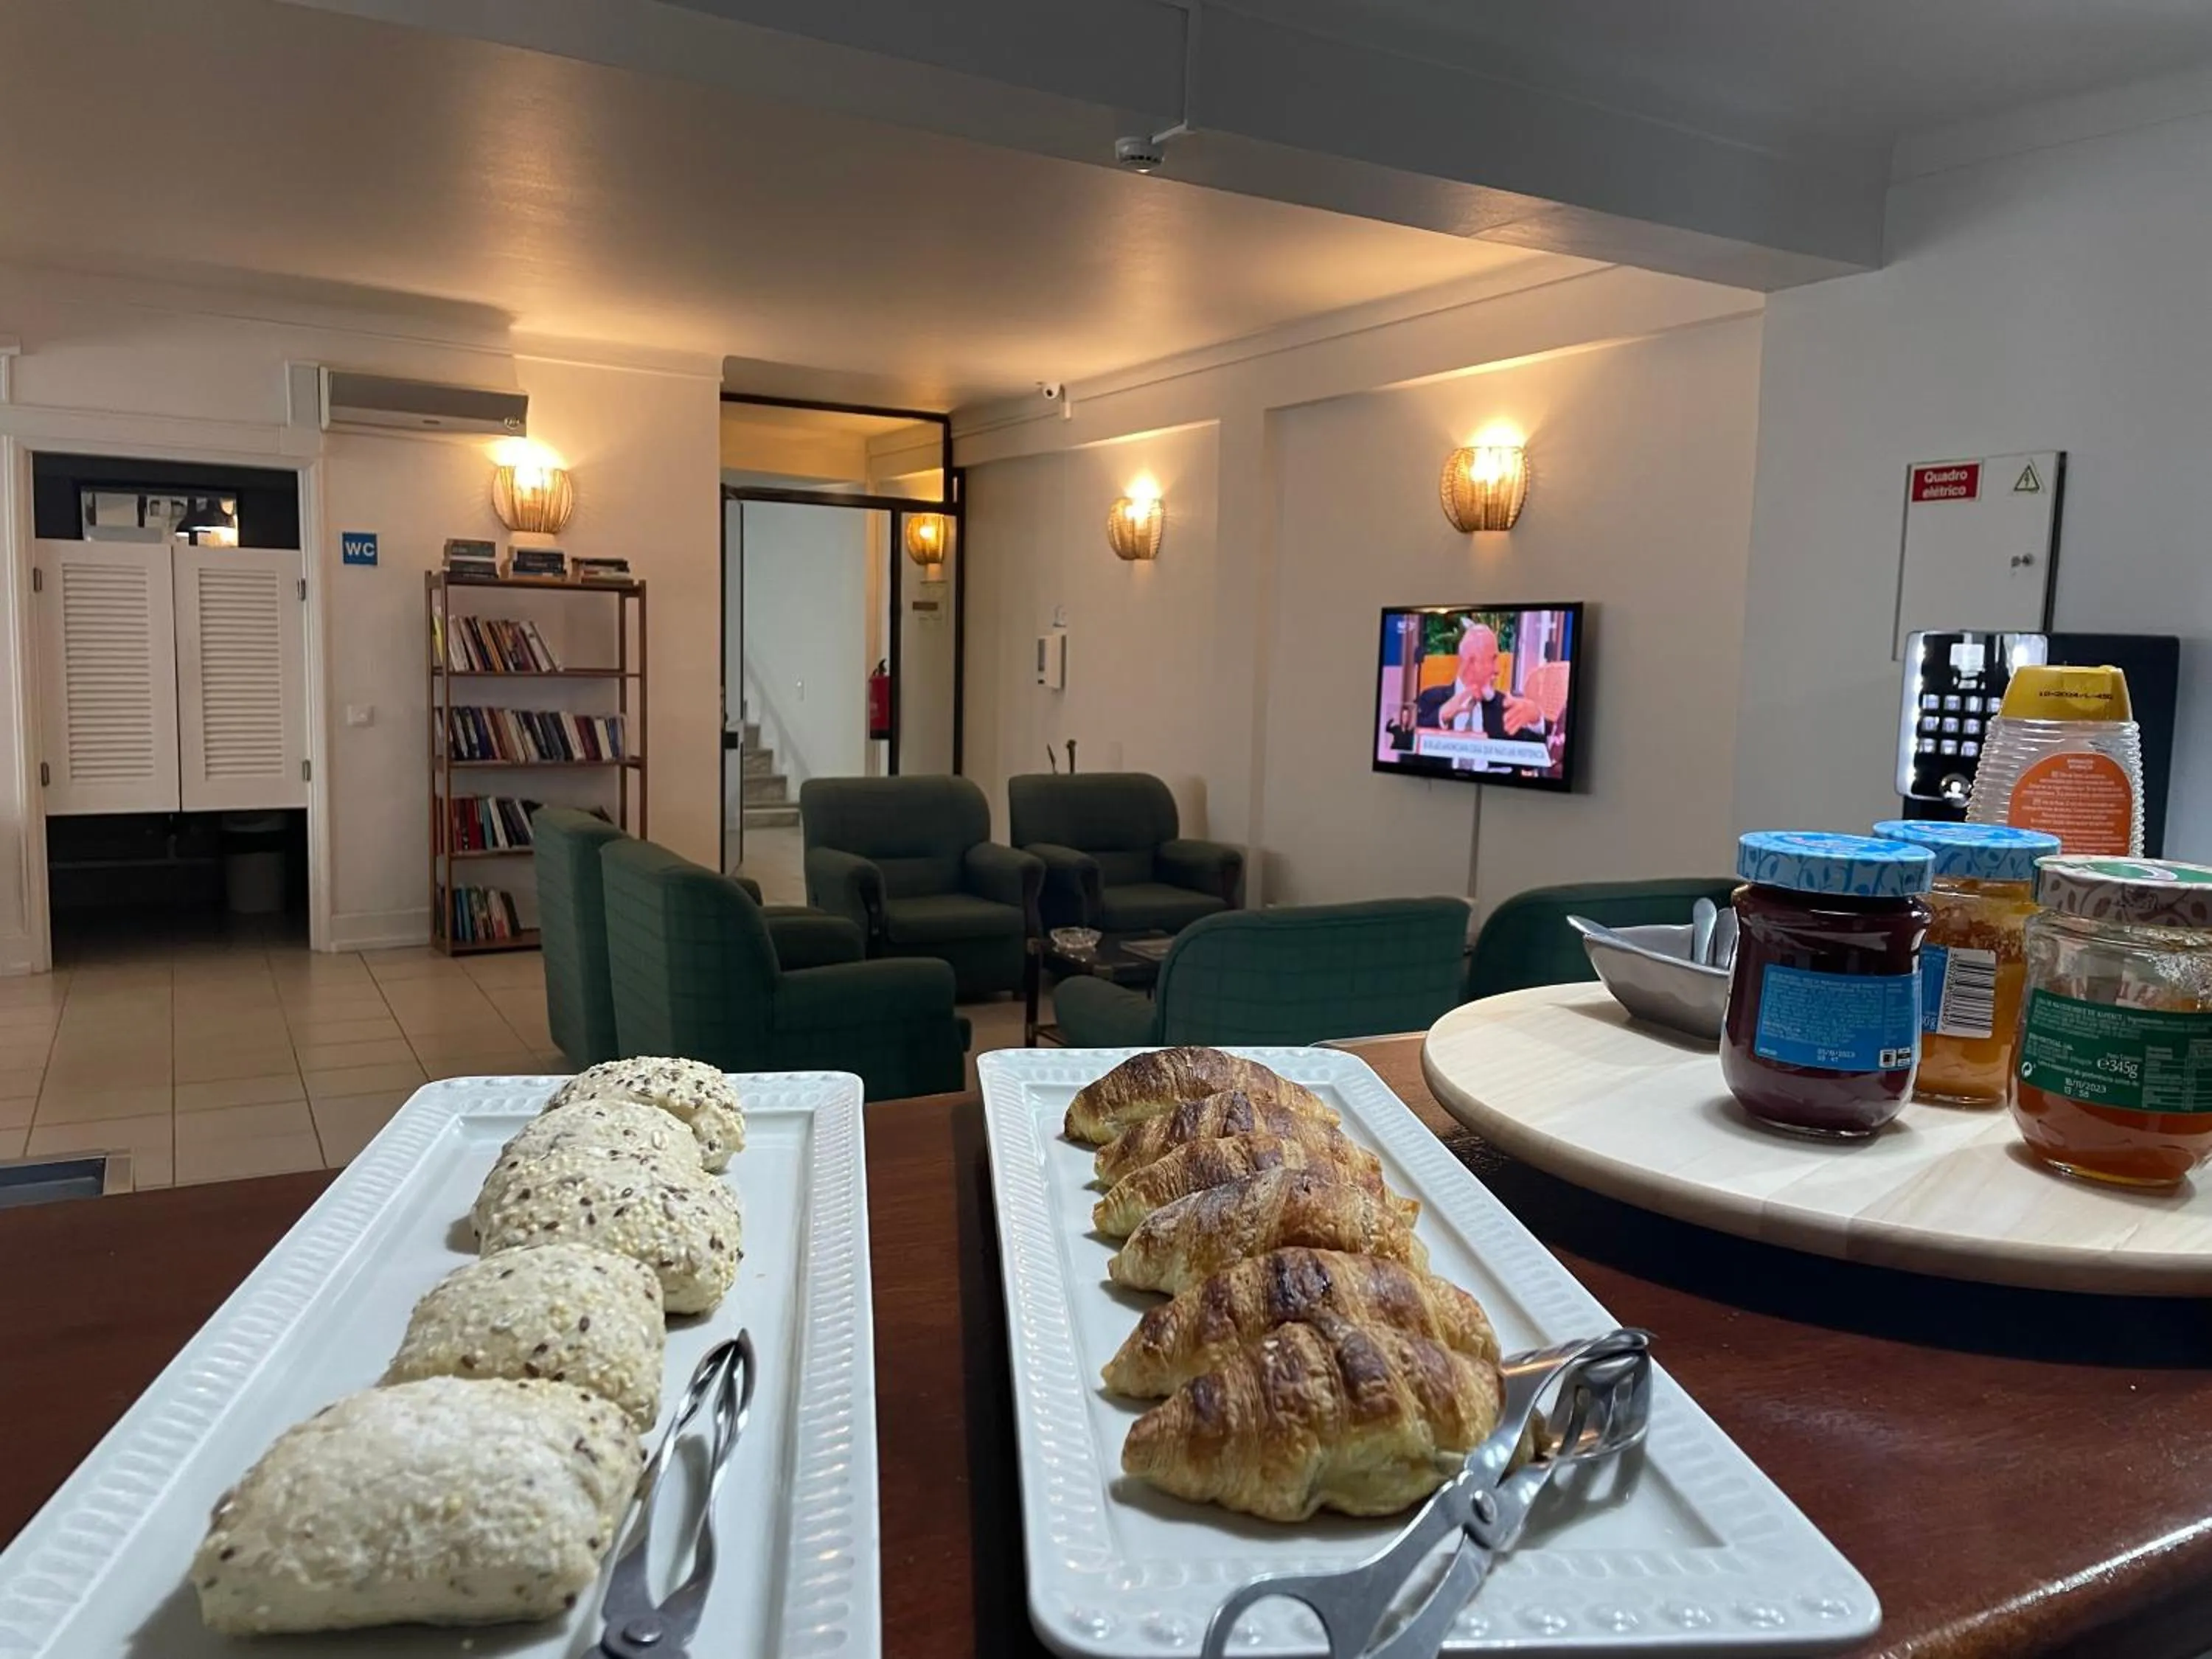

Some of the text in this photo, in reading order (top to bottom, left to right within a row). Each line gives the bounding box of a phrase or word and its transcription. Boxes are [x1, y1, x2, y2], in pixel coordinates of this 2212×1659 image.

[1924, 469, 1968, 484] Quadro
[1922, 484, 1966, 498] elétrico
[345, 542, 375, 556] WC
